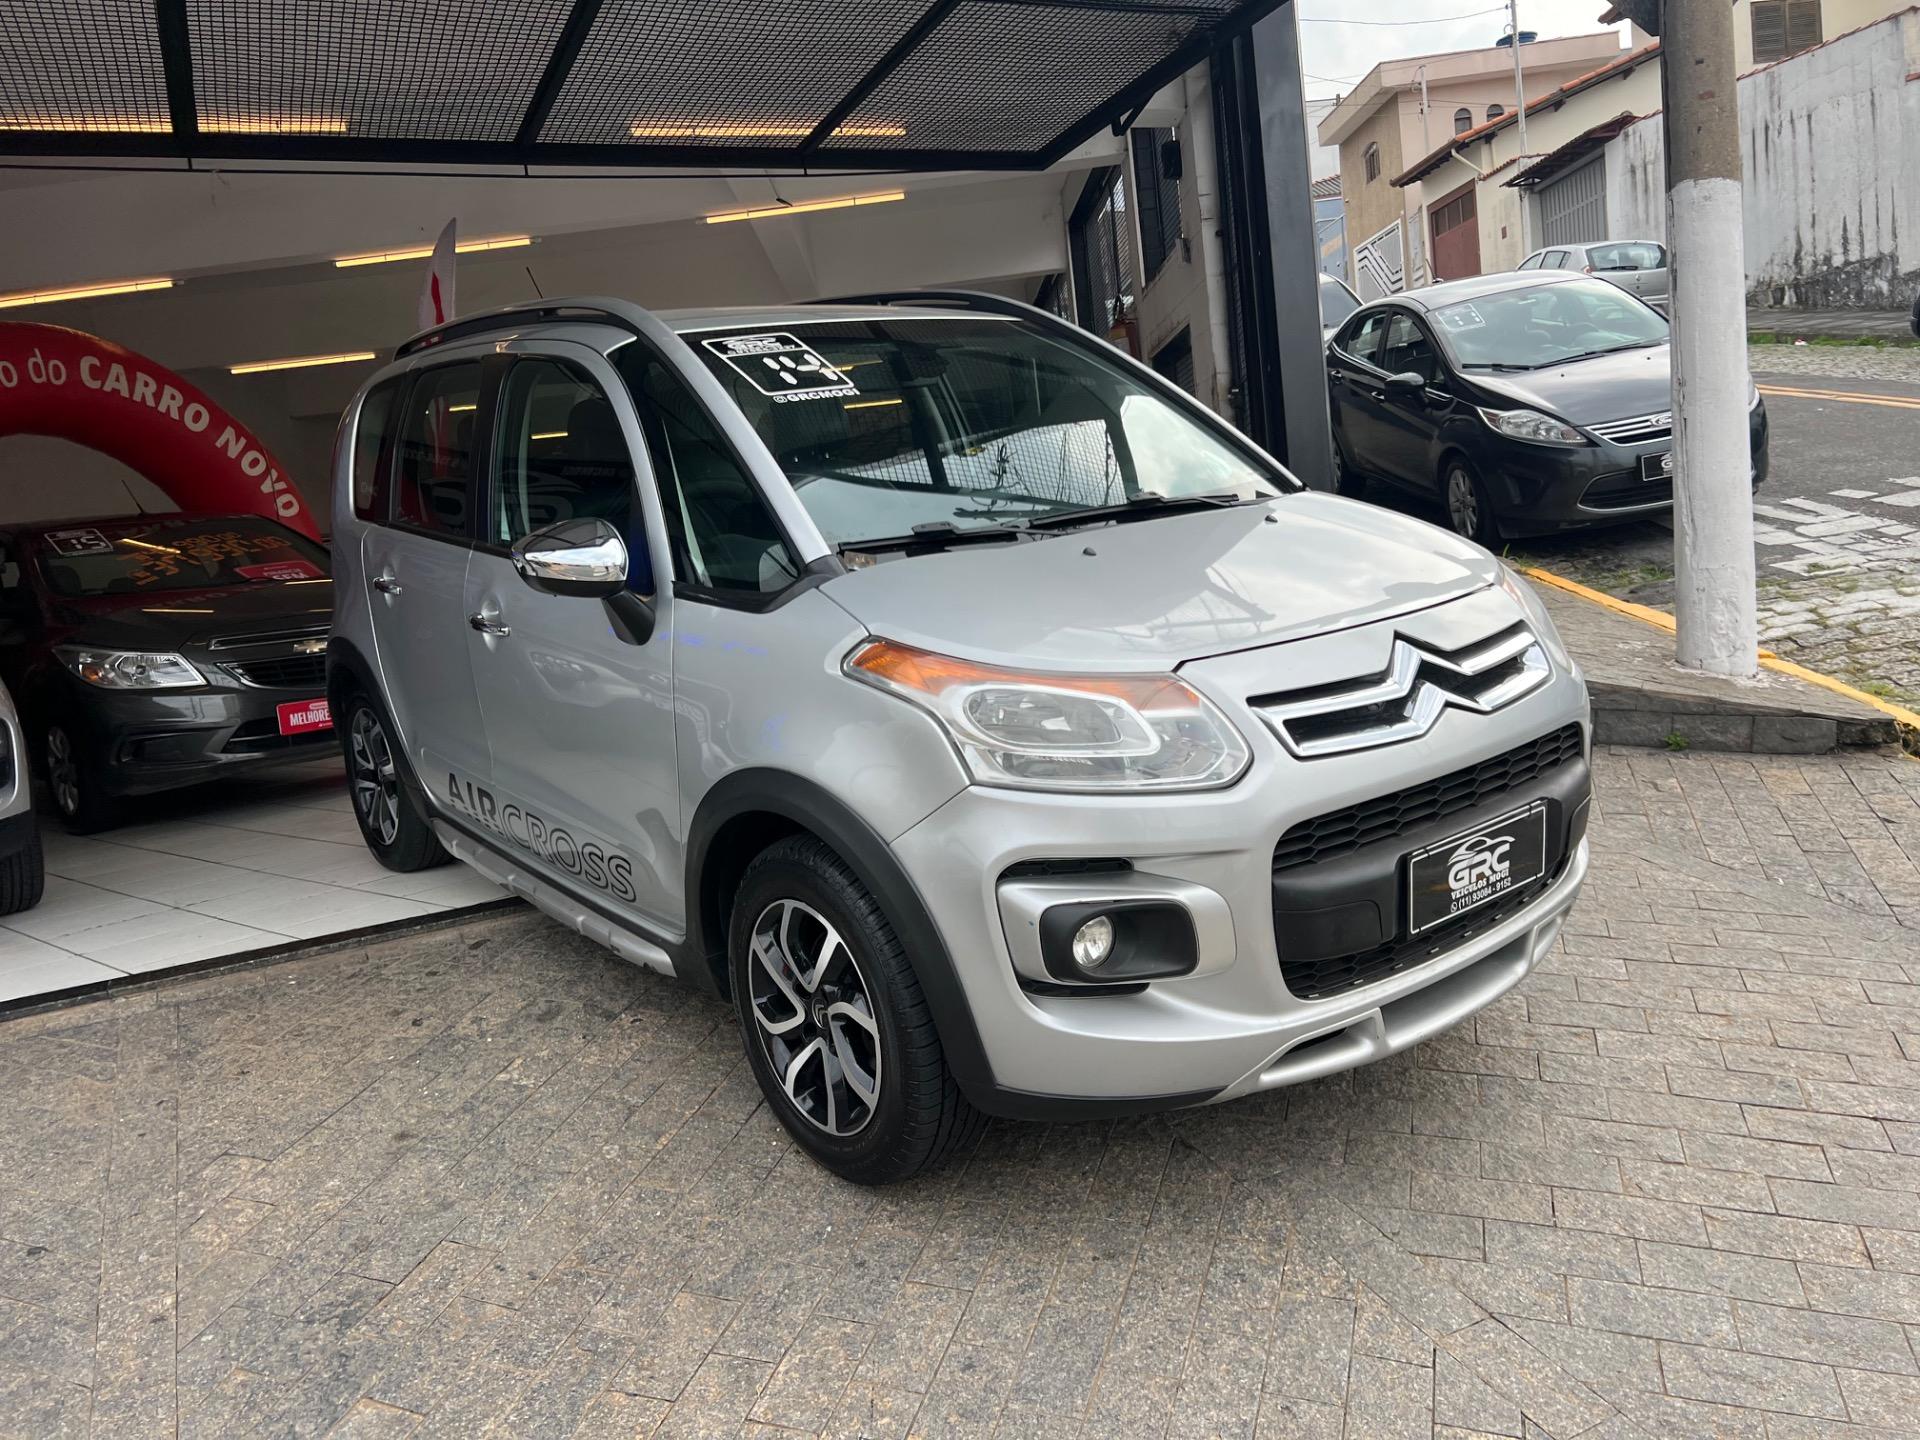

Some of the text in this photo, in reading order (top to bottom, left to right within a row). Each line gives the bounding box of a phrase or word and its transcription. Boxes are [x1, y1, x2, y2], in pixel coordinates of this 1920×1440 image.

[28, 348, 67, 385] do
[80, 355, 210, 432] CARRO
[215, 426, 300, 518] NOVO
[448, 772, 637, 902] AIRCROSS
[1448, 842, 1510, 890] GRC
[1450, 868, 1509, 900] VEICULOS MOGI
